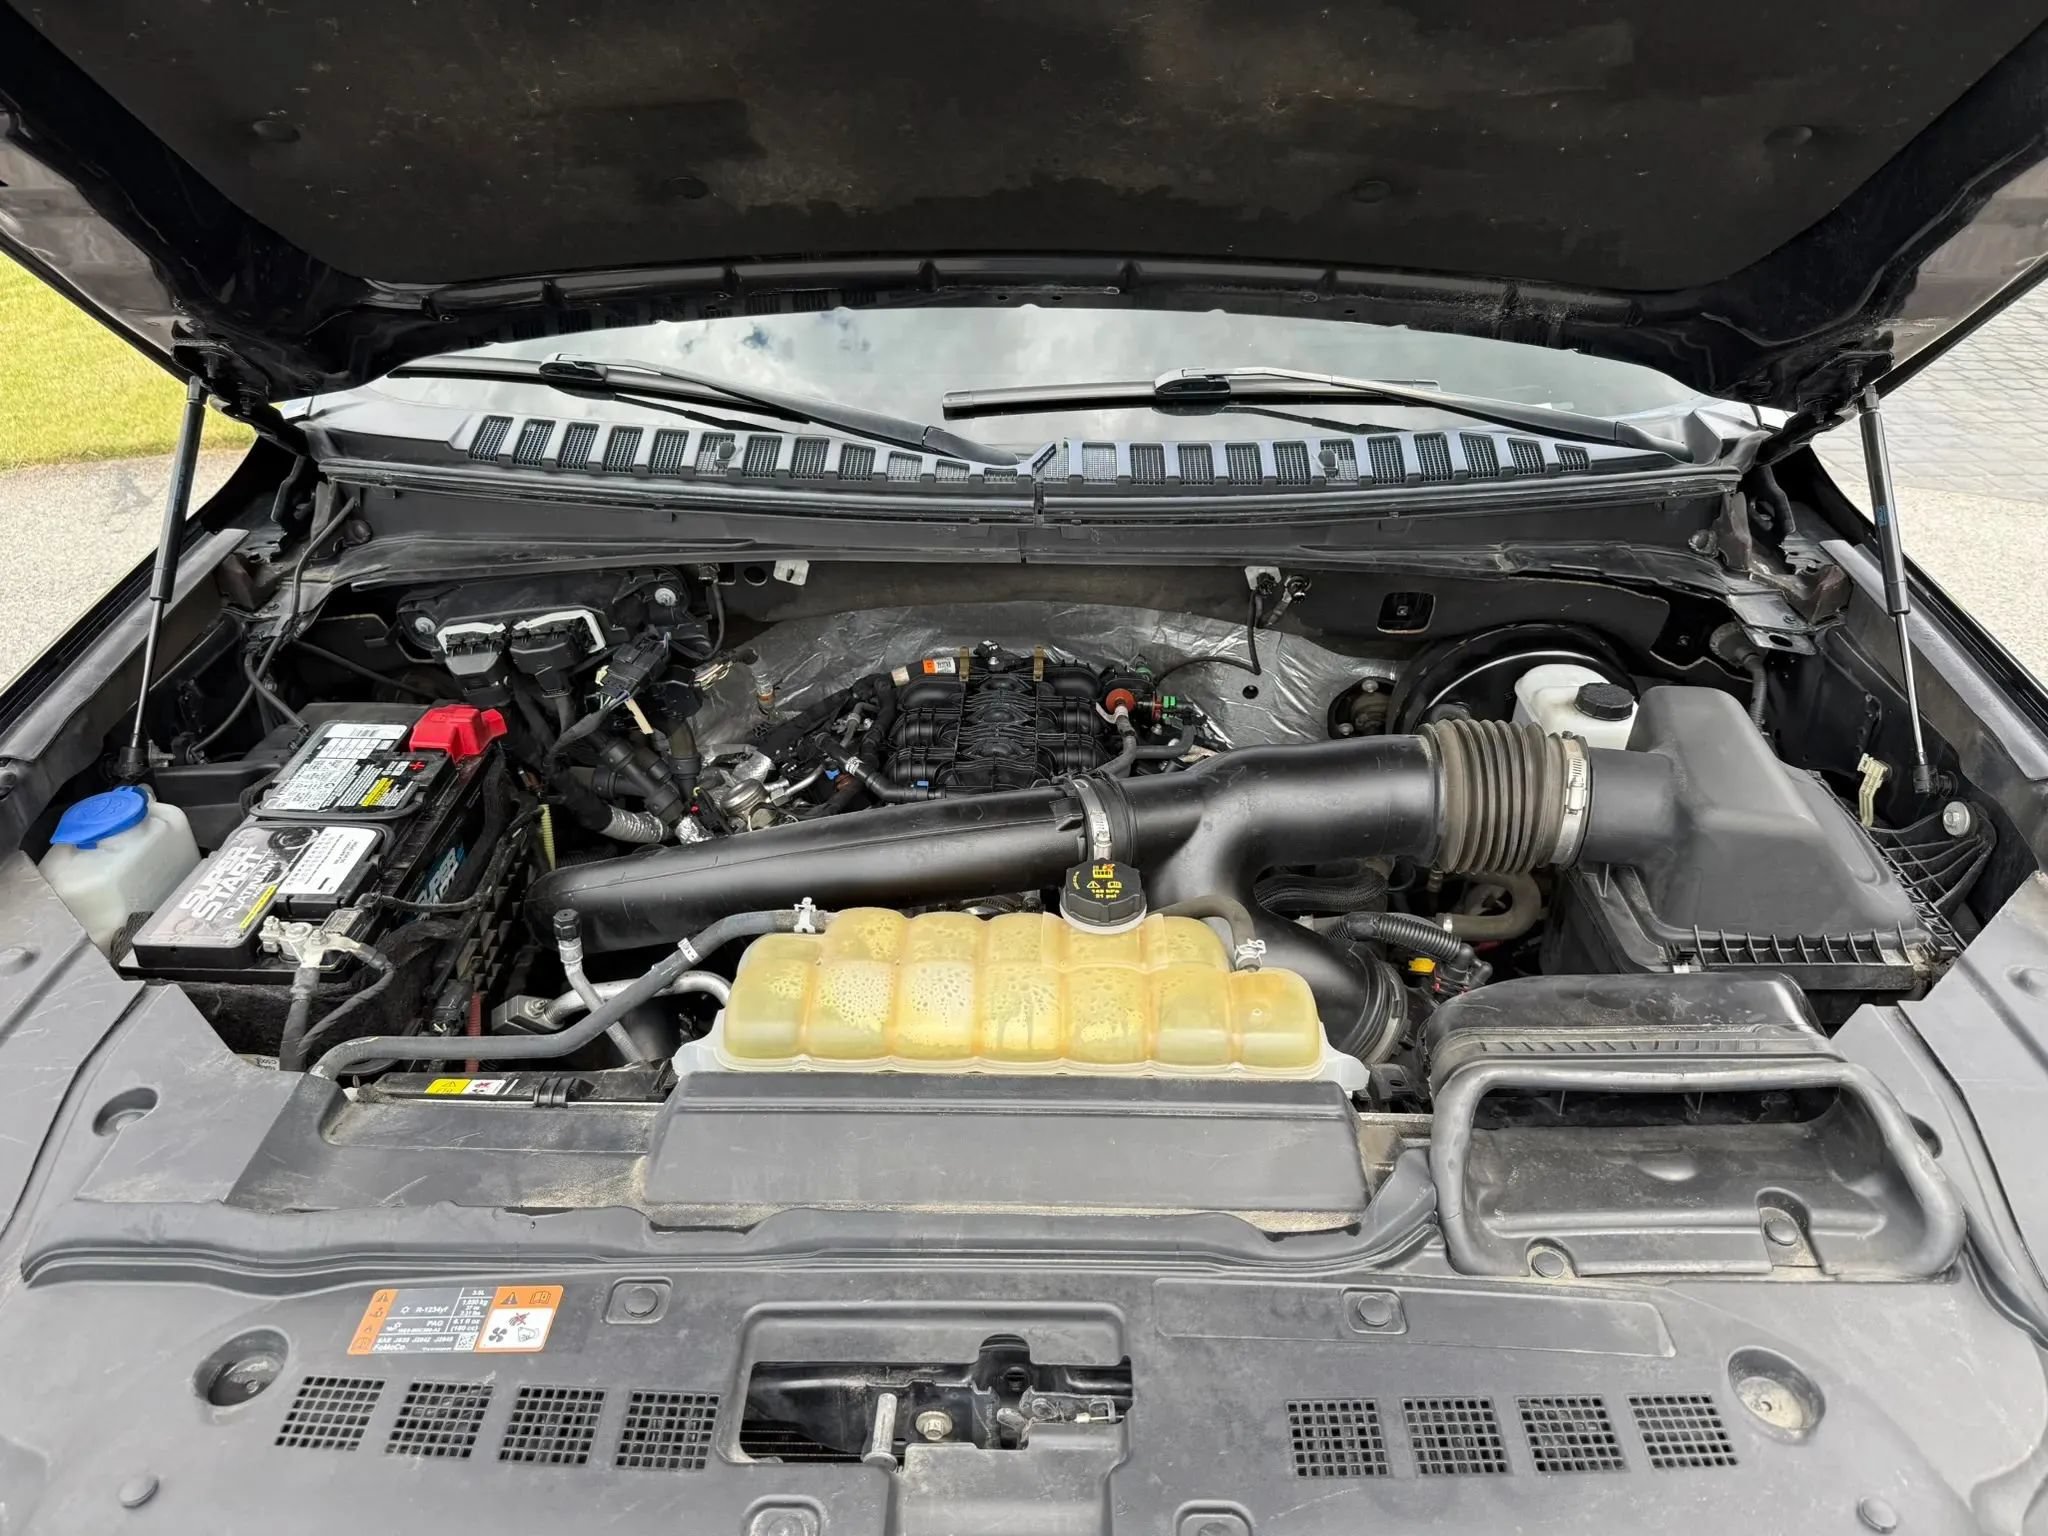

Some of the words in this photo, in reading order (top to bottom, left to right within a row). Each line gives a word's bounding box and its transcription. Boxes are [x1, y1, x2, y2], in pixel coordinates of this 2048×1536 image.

[179, 846, 249, 909] SUPER
[192, 846, 263, 921] START
[222, 860, 276, 919] PLATINUM
[415, 1306, 449, 1314] R-1234yf
